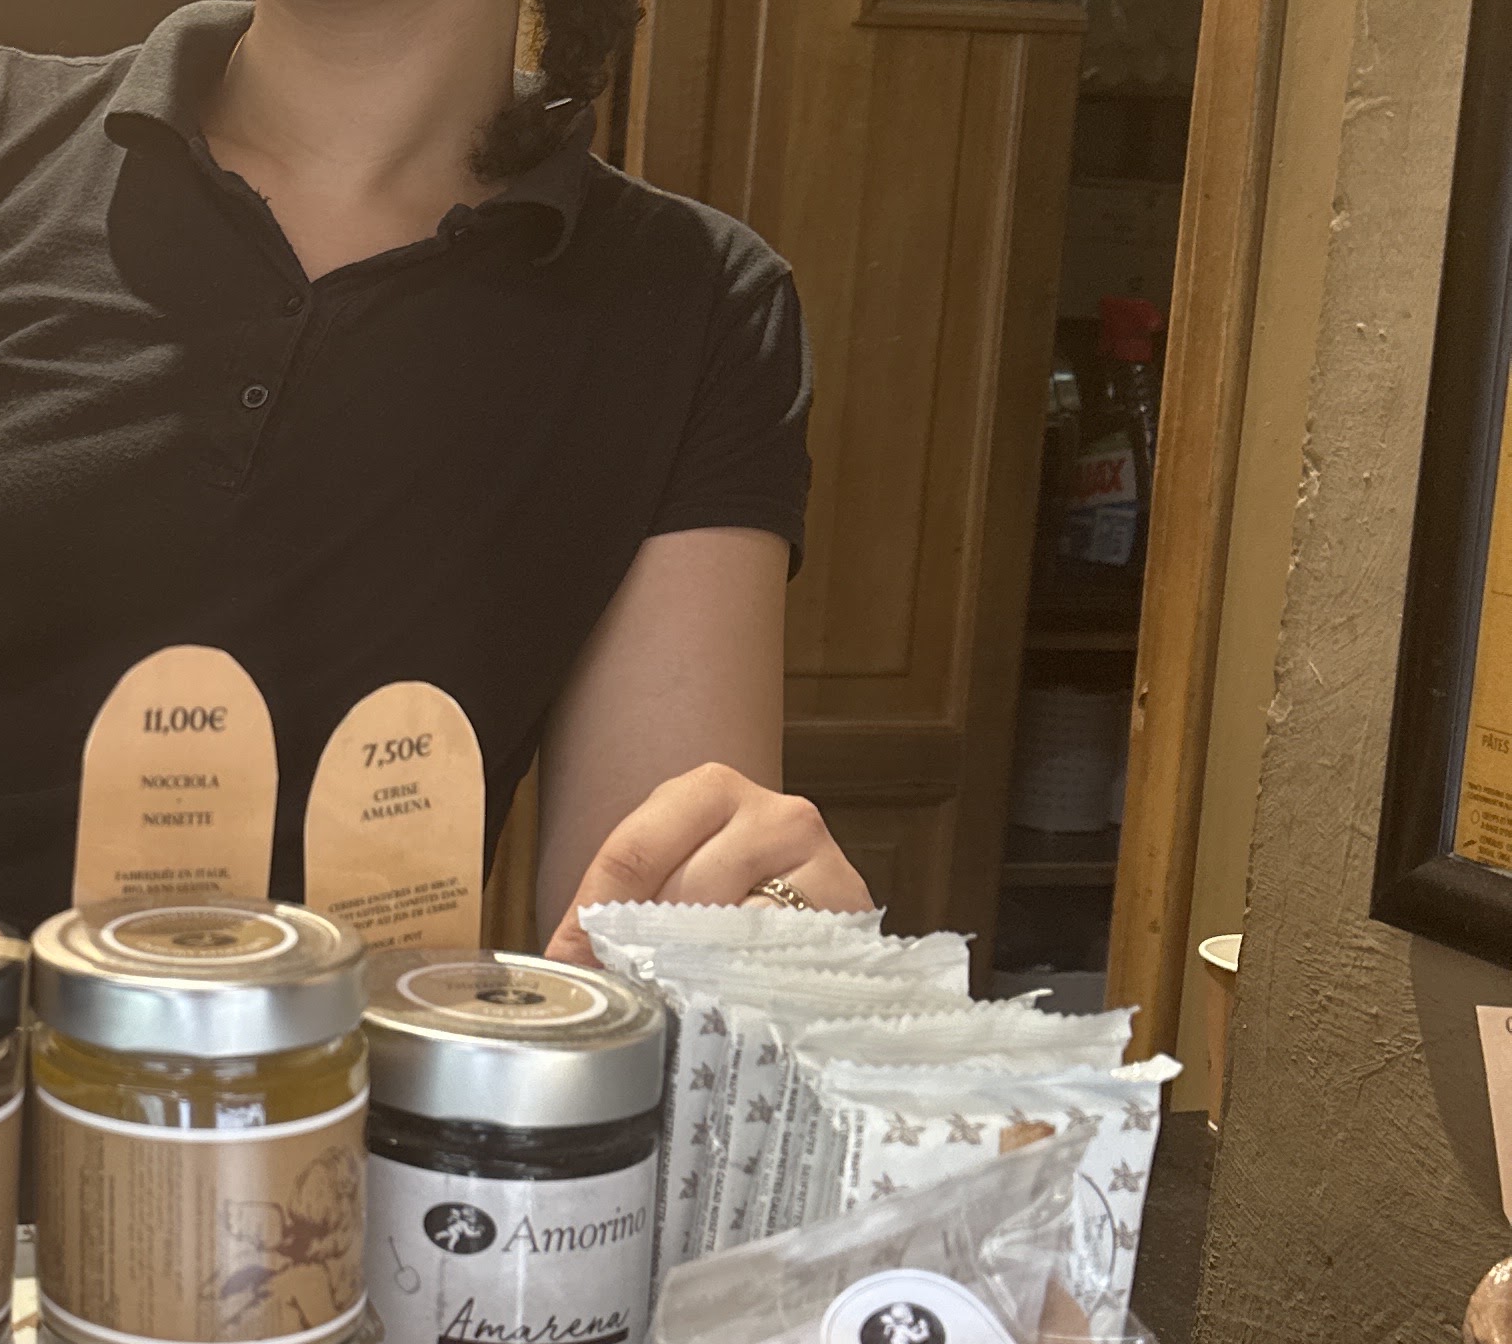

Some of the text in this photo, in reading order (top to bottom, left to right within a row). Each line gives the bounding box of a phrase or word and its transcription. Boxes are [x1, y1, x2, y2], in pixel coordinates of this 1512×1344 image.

[143, 707, 228, 735] 11,00€
[362, 734, 434, 769] 7,50€
[141, 774, 219, 789] NOCCIOLA
[373, 783, 419, 802] CERISE
[142, 811, 213, 827] NOISETTE
[361, 798, 431, 823] AMARENA
[501, 1203, 646, 1254] Amorino
[443, 1297, 629, 1343] Amarena
